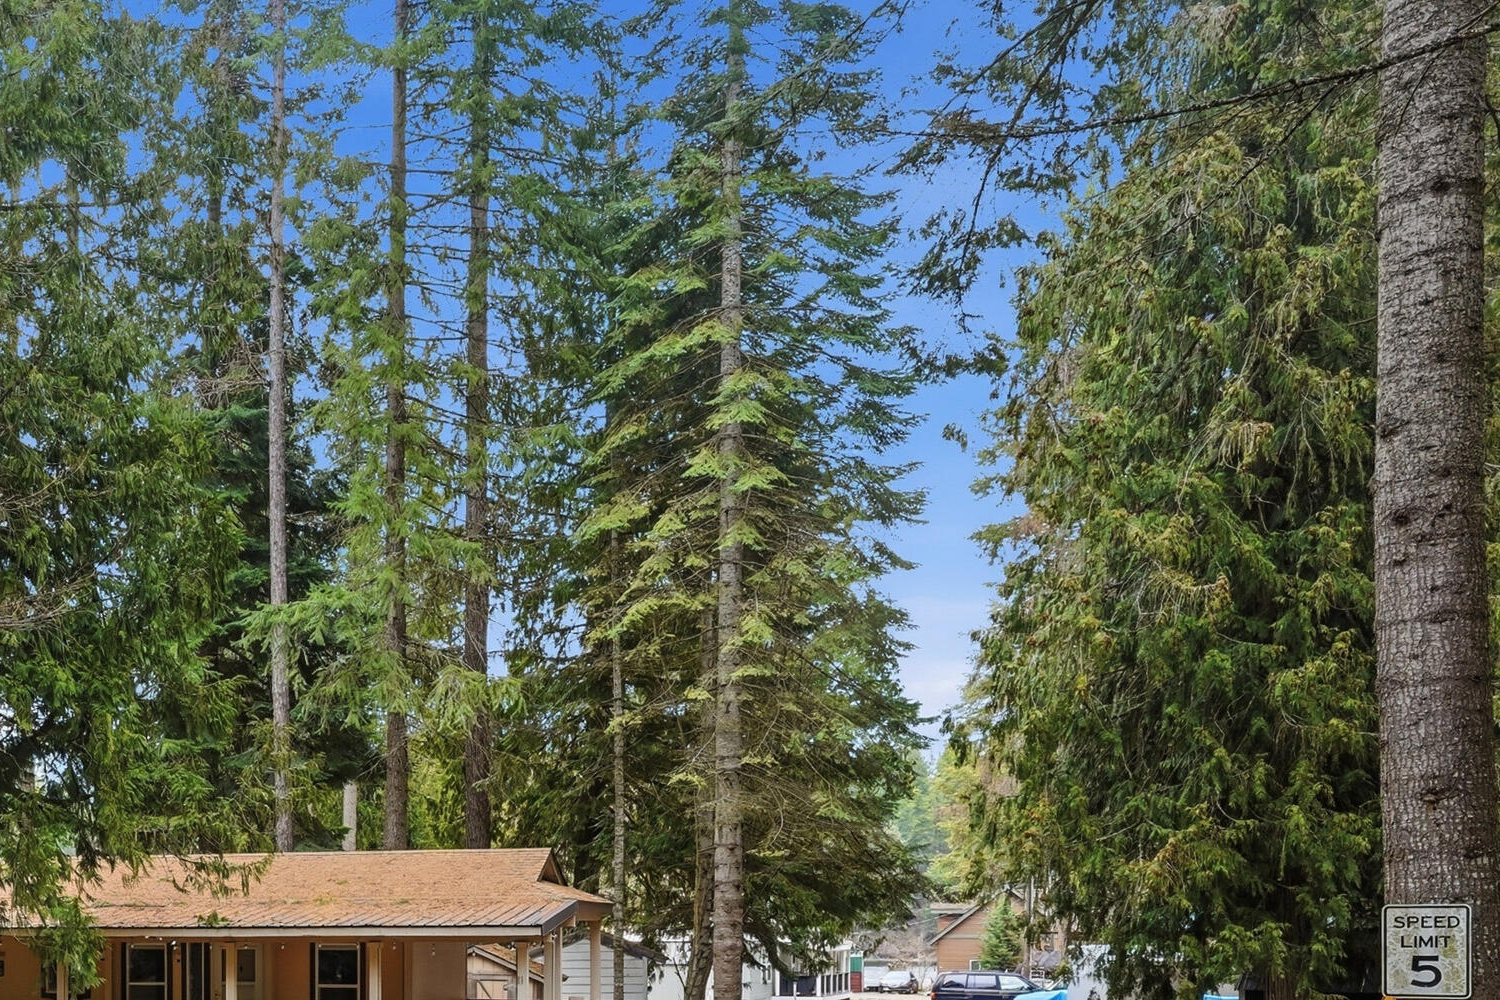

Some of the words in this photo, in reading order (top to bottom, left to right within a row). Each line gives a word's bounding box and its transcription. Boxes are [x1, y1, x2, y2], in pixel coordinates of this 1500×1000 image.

[1393, 915, 1460, 929] SPEED
[1400, 935, 1451, 948] LIMIT
[1410, 955, 1442, 988] 5
